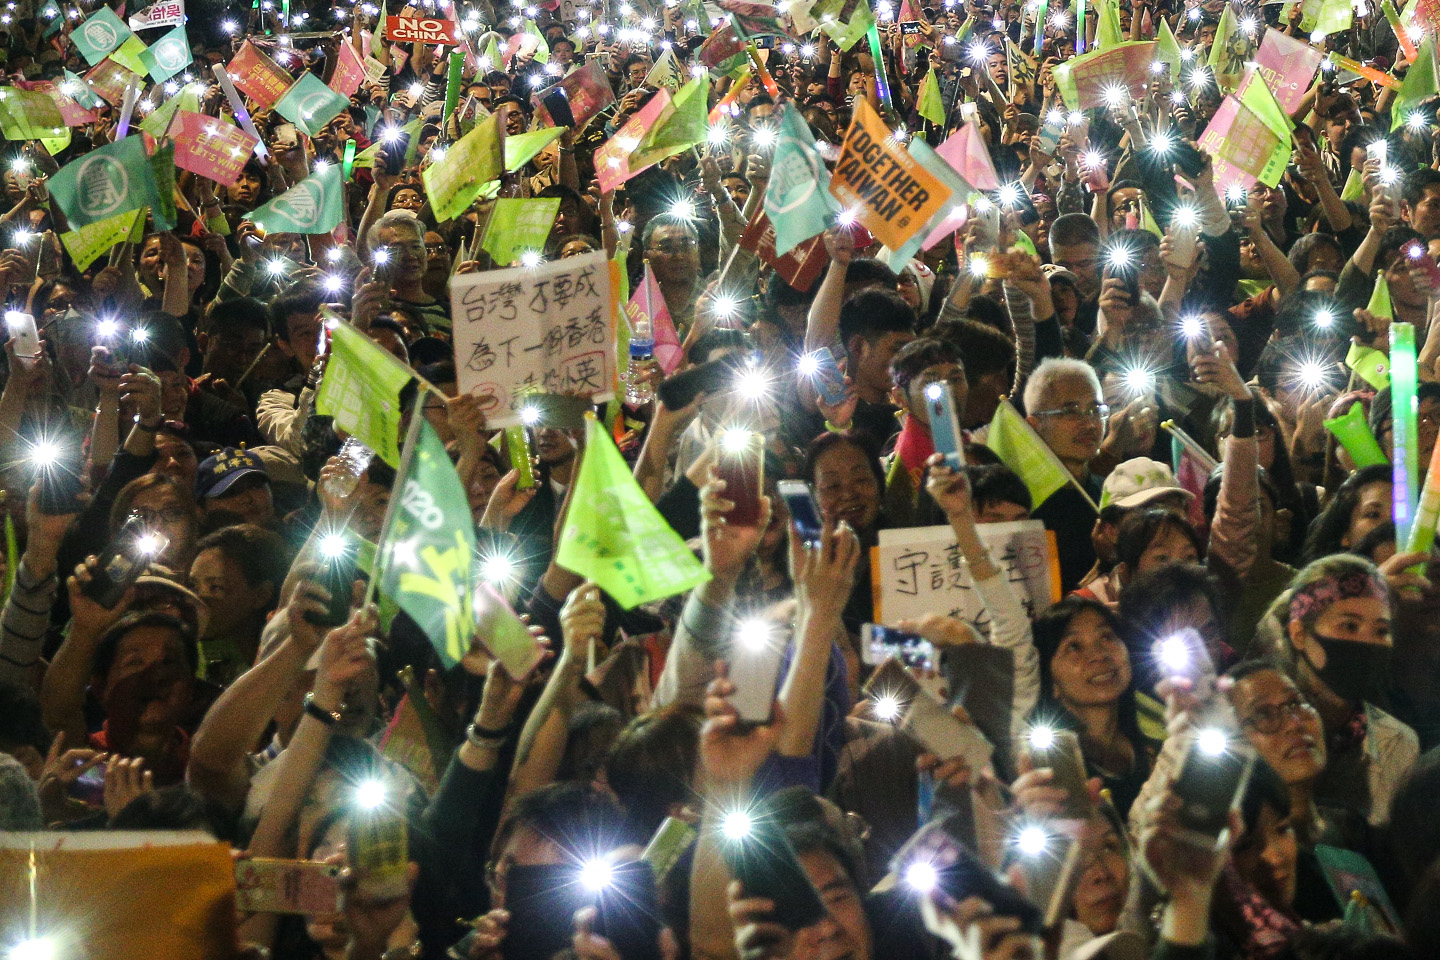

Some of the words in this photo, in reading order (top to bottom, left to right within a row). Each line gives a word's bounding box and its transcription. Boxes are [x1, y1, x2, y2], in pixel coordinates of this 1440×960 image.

[392, 29, 450, 42] CHINA
[399, 17, 443, 32] NO
[838, 148, 904, 223] TAIWAN
[846, 120, 930, 213] TOGETHER
